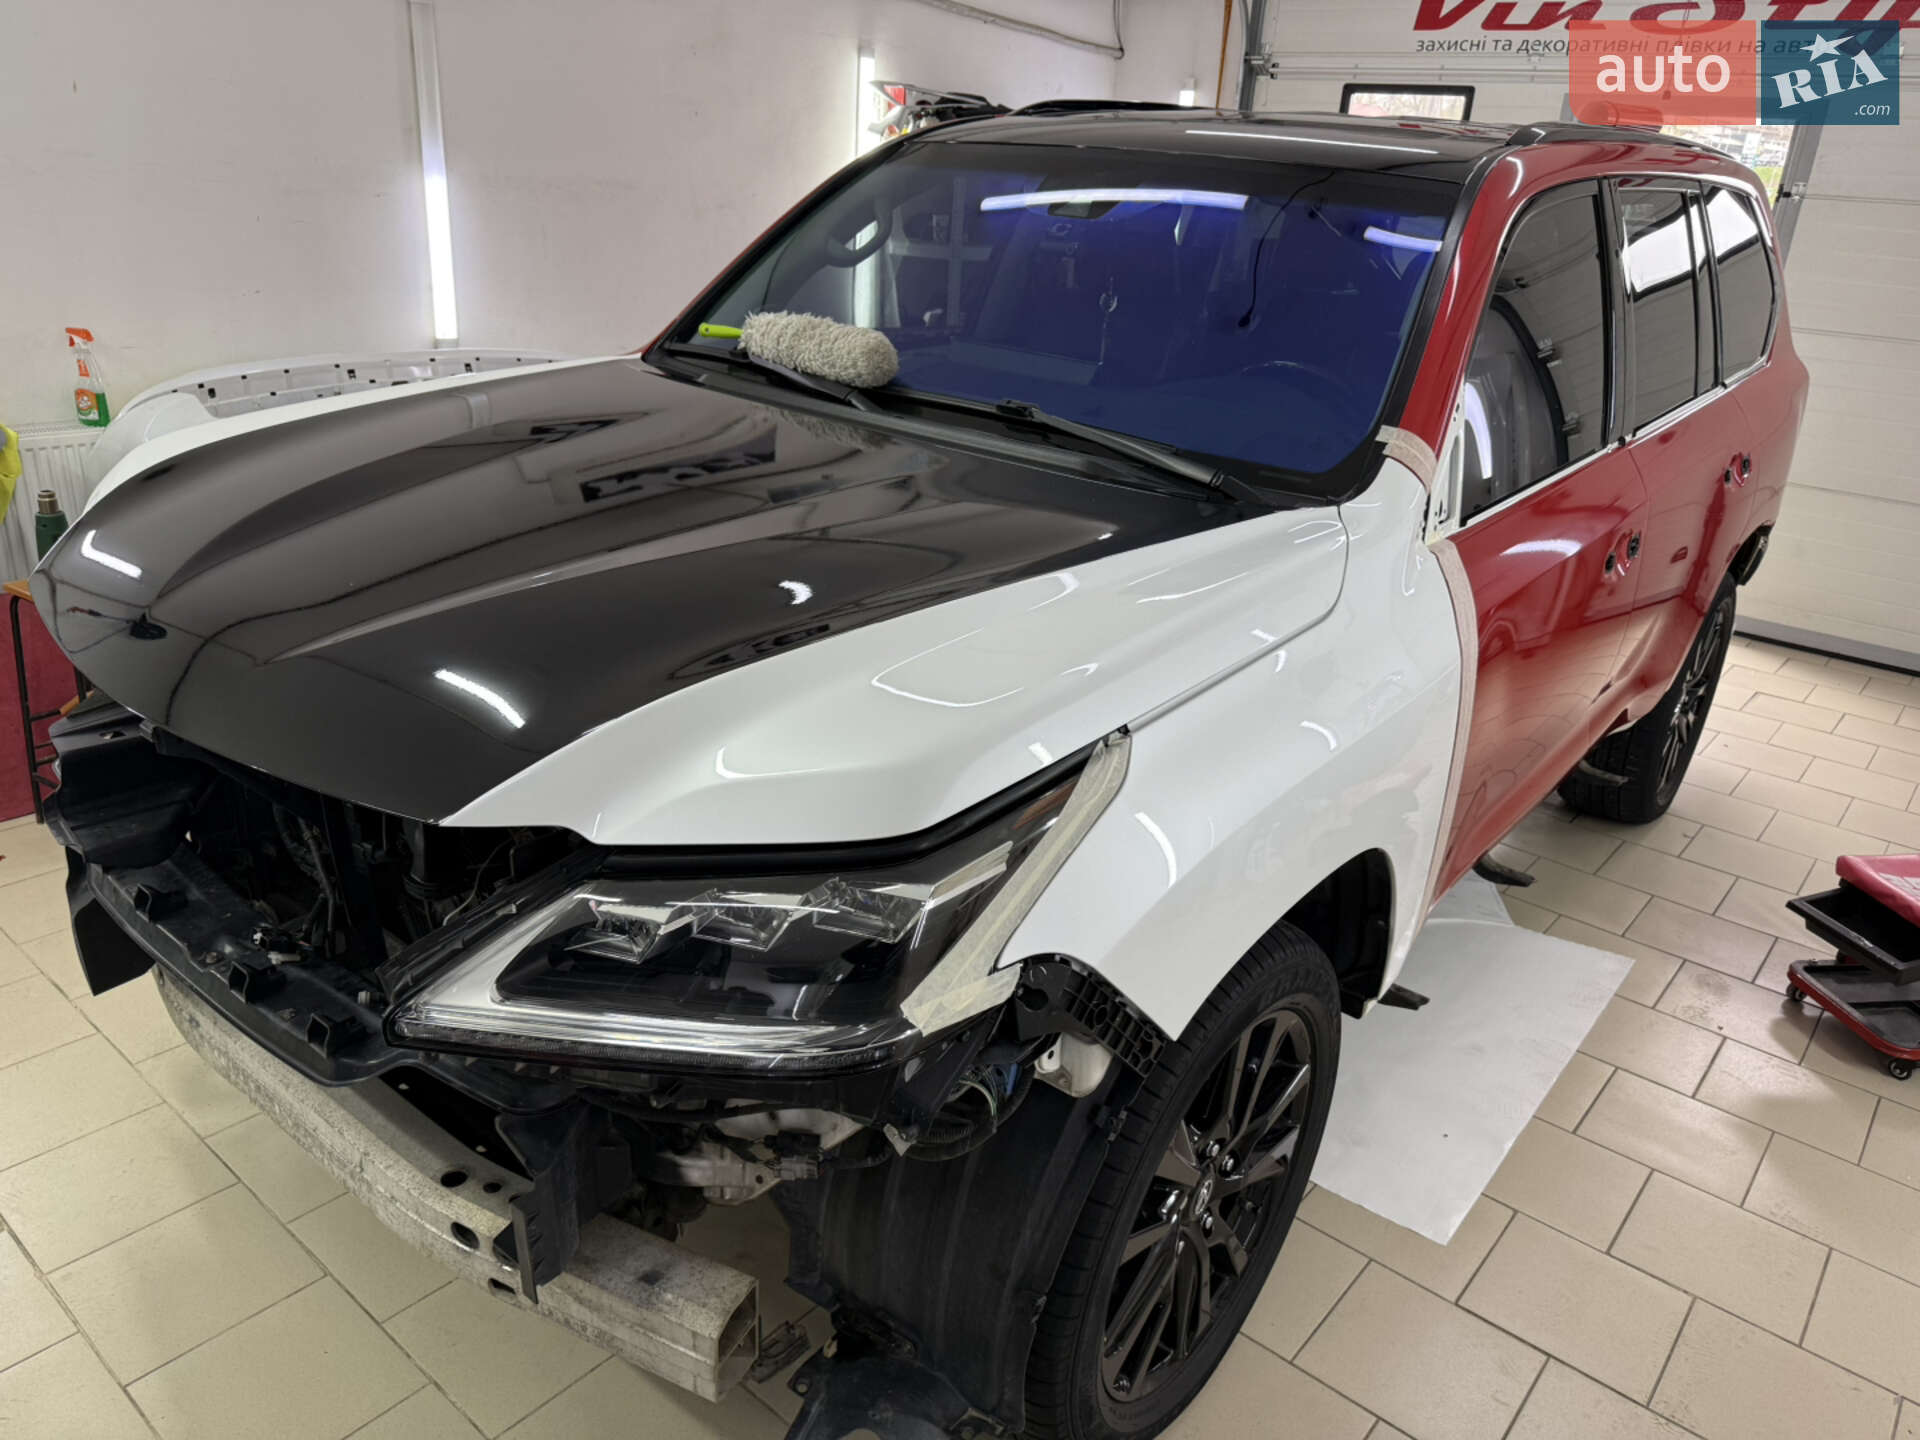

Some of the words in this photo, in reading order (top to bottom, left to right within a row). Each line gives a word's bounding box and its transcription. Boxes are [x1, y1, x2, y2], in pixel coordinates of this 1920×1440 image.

[1416, 35, 1488, 52] захисні
[1492, 38, 1512, 52] та
[1516, 36, 1650, 56] декоративні
[1656, 36, 1731, 53] плівки
[1738, 39, 1766, 53] на
